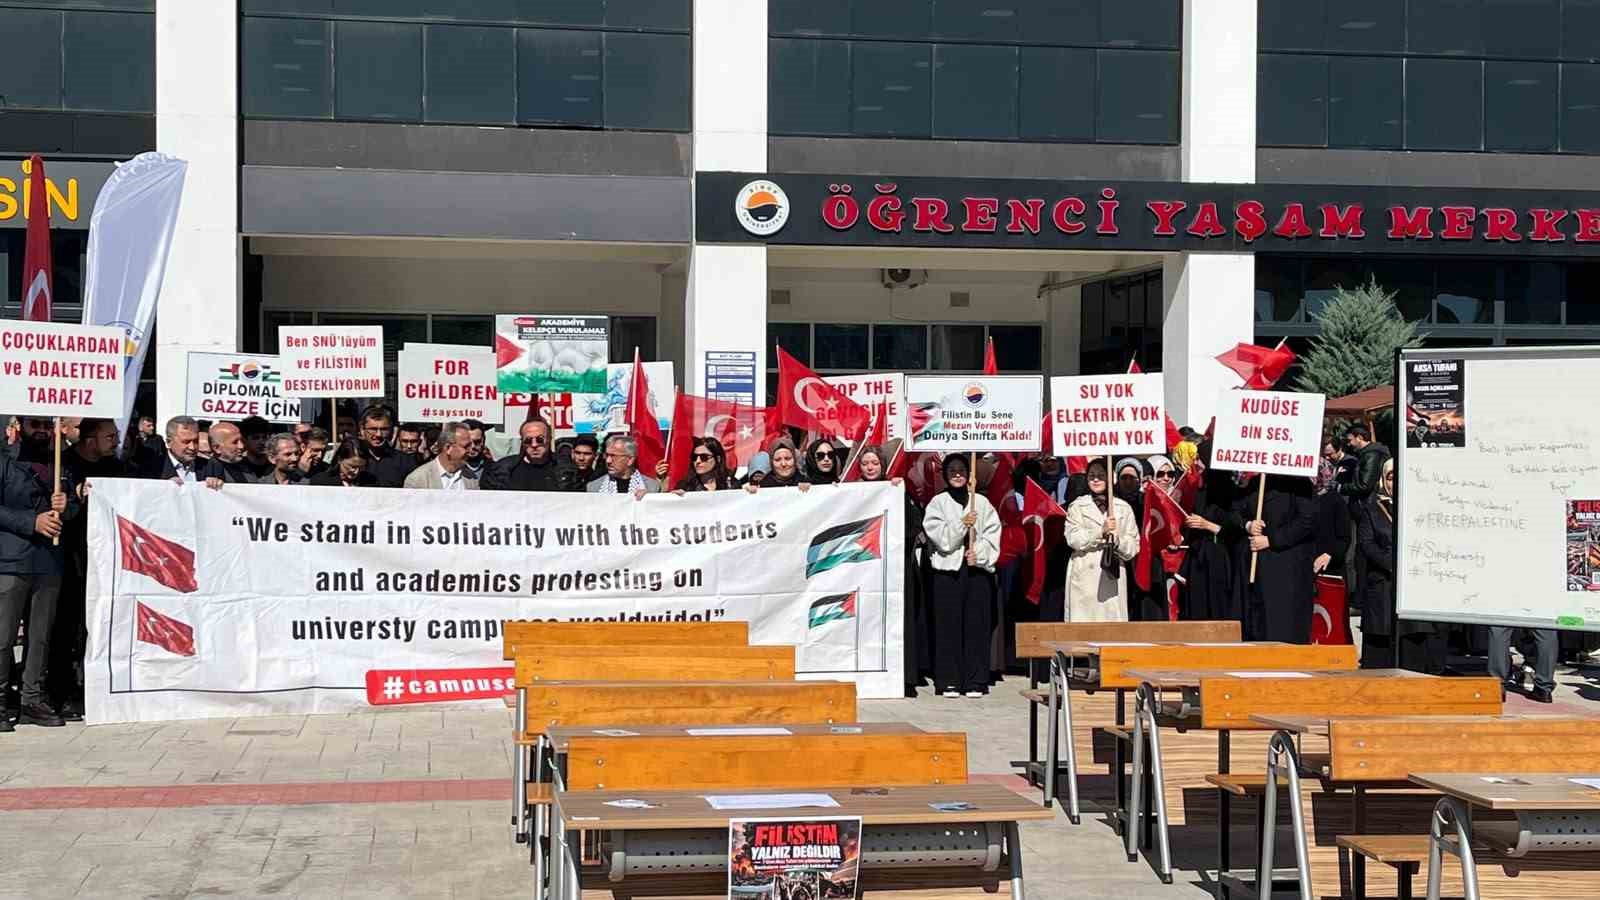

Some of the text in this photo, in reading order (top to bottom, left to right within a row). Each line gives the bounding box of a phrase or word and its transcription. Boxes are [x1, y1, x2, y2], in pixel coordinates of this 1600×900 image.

[822, 183, 1600, 243] ÖĞRENCİ YAŞAM MERKE
[2, 331, 120, 355] ÇOÇUKLARDAN
[286, 336, 308, 348] Ben
[4, 359, 117, 381] ve ADALETTEN
[297, 357, 368, 370] ve FİLİSTİNİ
[435, 360, 470, 376] FOR
[202, 380, 283, 399] DİPLOMAL
[284, 377, 381, 392] DESTEKLİYORUM
[864, 380, 894, 396] THE
[1080, 384, 1135, 399] SU YOK
[28, 386, 94, 406] TARAFIZ
[201, 398, 300, 420] GAZZE İÇİN
[941, 410, 1013, 419] Filistin Bu Sene
[1056, 405, 1160, 424] ELEKTRİK YOK
[1241, 396, 1299, 417] KUDÜSE
[943, 421, 972, 430] Mezun
[1241, 423, 1261, 440] BİN
[1064, 428, 1155, 447] VİCDAN YOK
[1216, 448, 1315, 469] GAZZEYE SELAM
[232, 516, 778, 549] “We stand in solidarity with the students
[315, 567, 703, 596] and academics protesting on
[291, 616, 557, 643] universty camp
[383, 676, 515, 699] #campuse
[751, 845, 791, 860] YALNIZ
